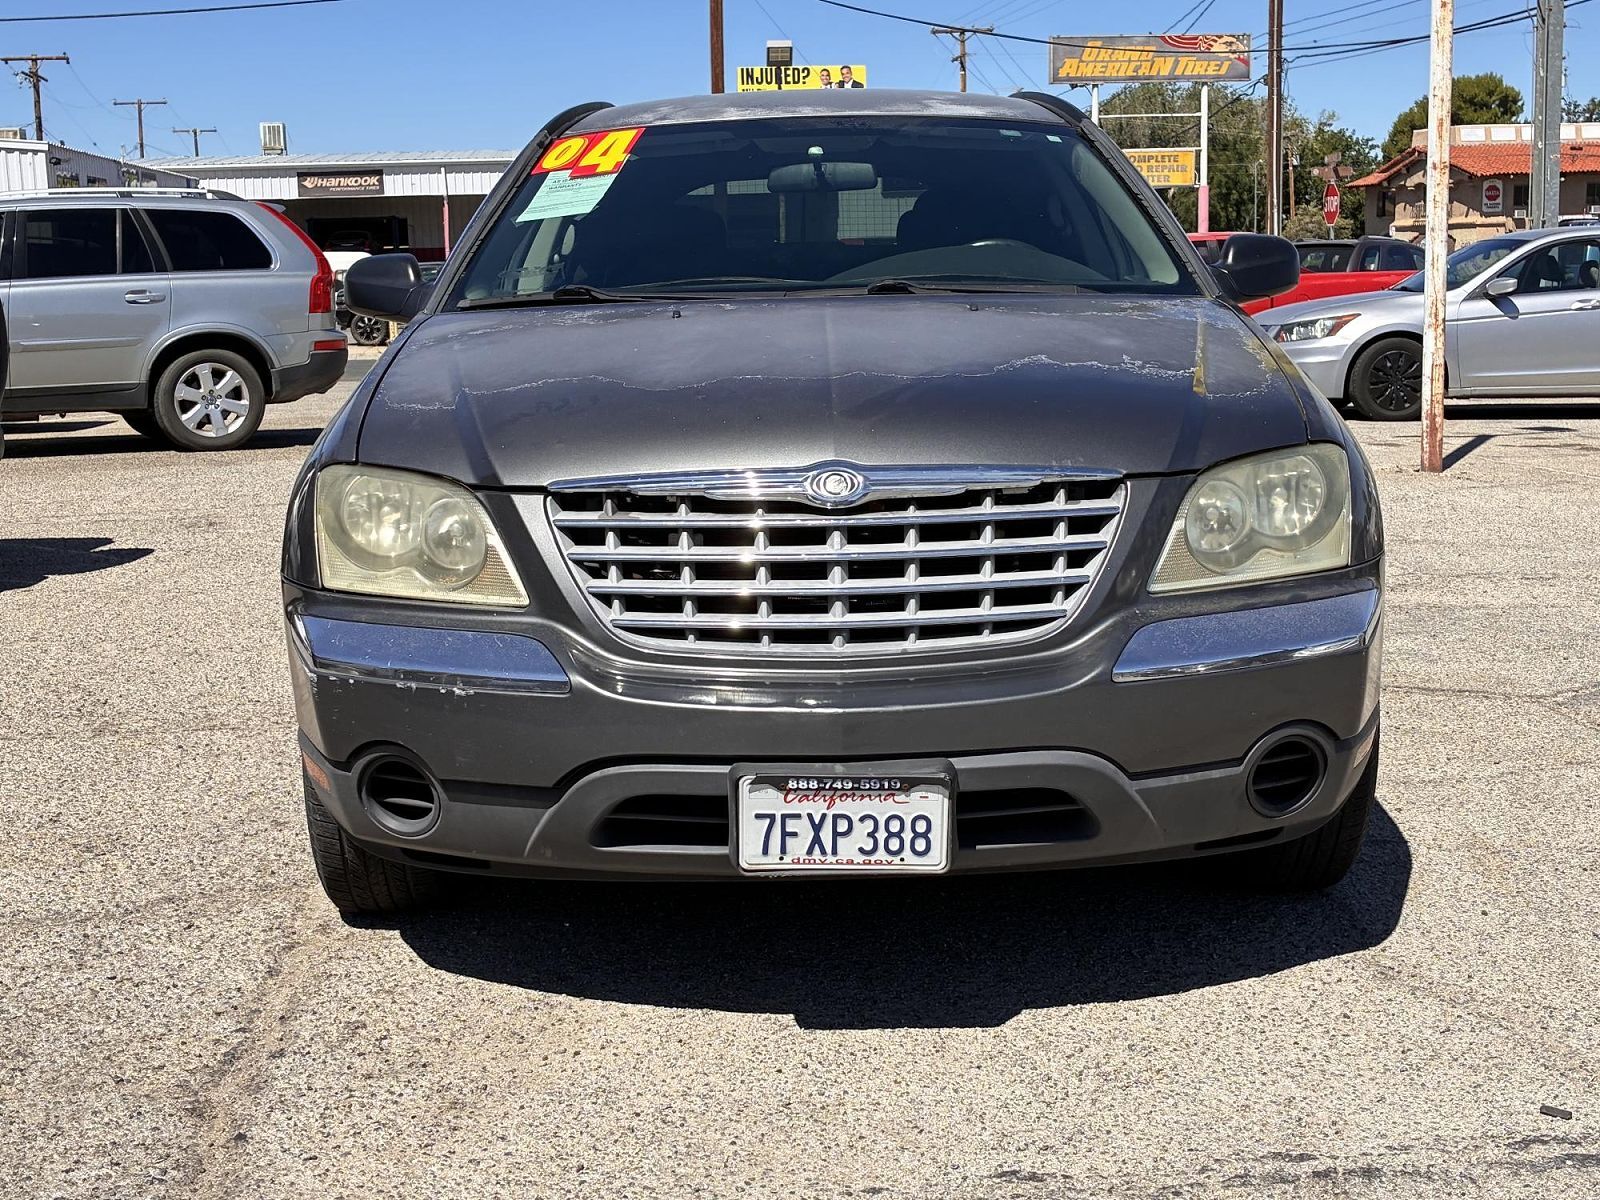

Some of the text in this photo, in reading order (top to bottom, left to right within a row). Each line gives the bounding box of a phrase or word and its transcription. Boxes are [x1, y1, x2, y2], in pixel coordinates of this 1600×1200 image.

[1081, 40, 1157, 61] GRAND
[1058, 57, 1232, 77] AMERICAN TIRES
[541, 129, 639, 173] 04
[1128, 154, 1179, 164] OMPLETE
[1147, 165, 1188, 173] REPAIR
[1325, 196, 1338, 213] STOP
[788, 779, 900, 790] 888-749-5919
[783, 786, 910, 810] California
[754, 812, 932, 857] 7FXP388
[791, 857, 894, 865] dmv.ca.gov
